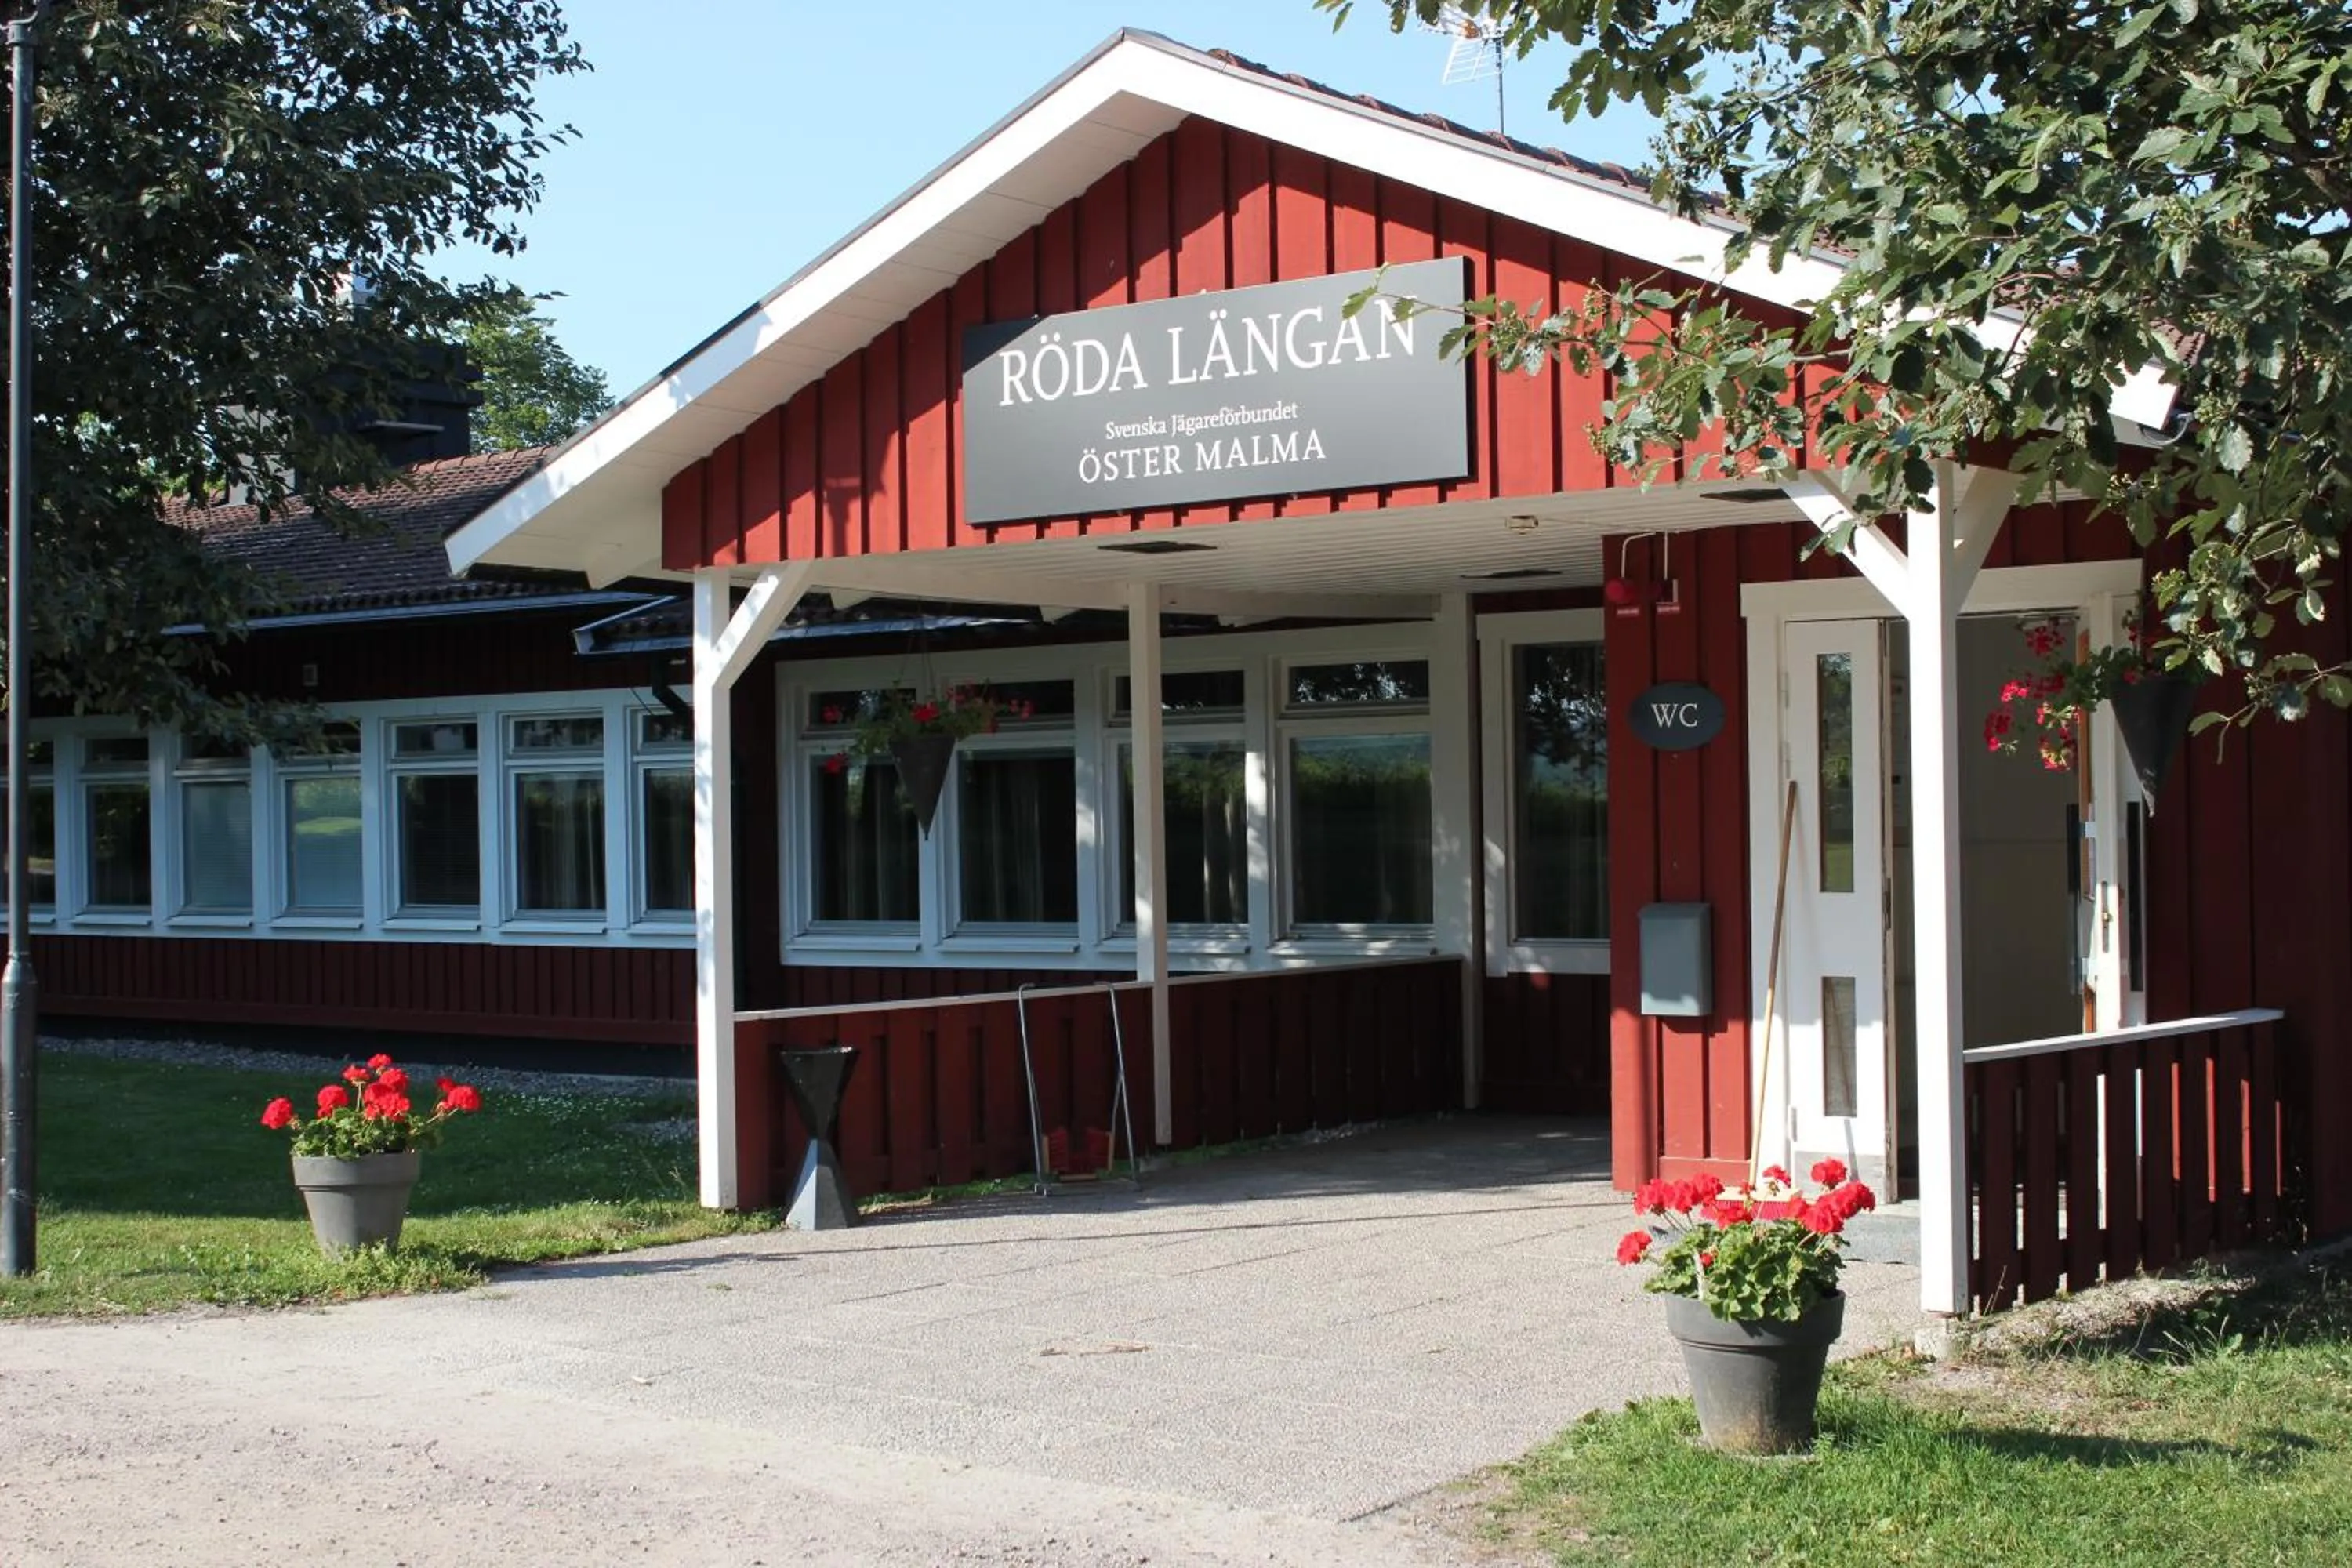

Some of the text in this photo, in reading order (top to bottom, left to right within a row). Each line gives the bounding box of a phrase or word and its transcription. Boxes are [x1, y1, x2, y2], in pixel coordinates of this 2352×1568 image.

[999, 295, 1417, 406] RÖDA LÄNGAN
[1105, 401, 1298, 440] Svenska Jägareförbundet
[1078, 428, 1326, 484] ÖSTER MALMA
[1651, 703, 1697, 728] WC
